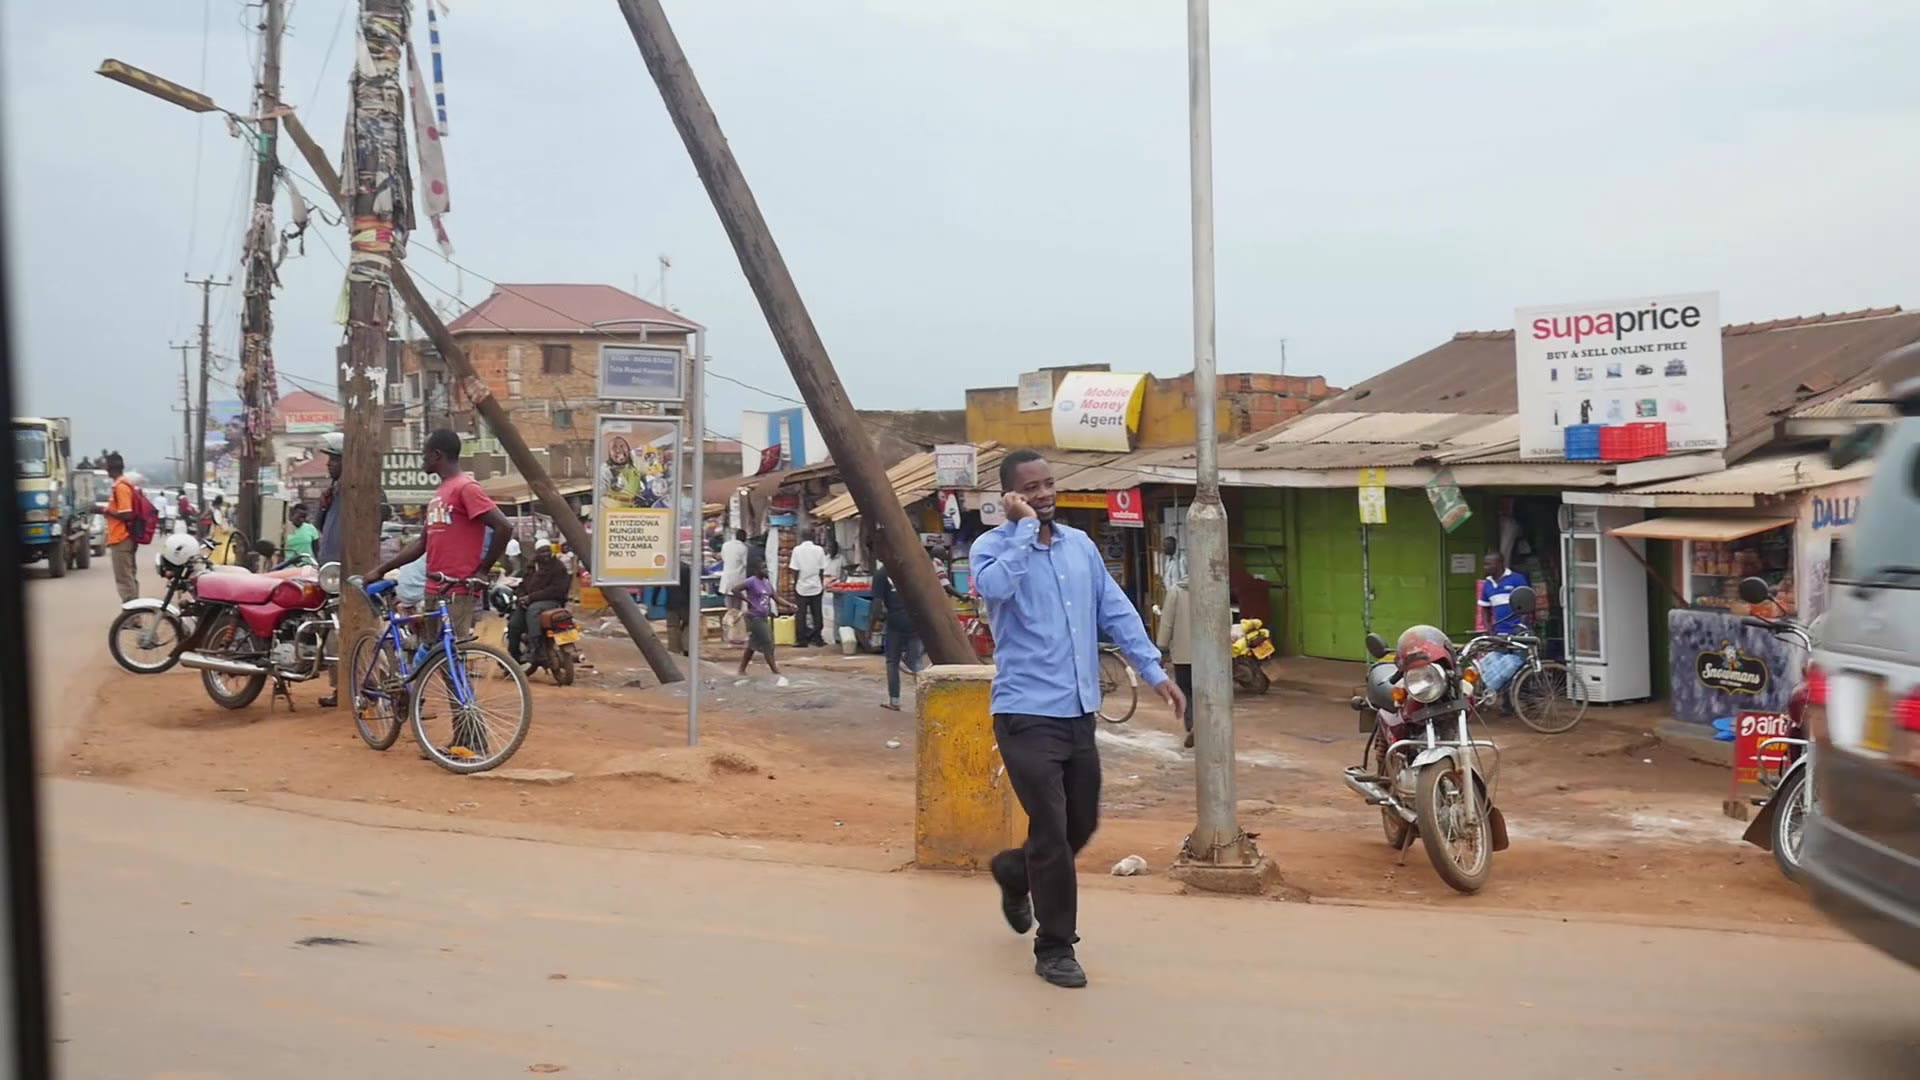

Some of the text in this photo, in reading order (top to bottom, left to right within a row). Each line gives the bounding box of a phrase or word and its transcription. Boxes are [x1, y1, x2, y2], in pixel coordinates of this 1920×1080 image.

[1532, 303, 1701, 344] supaprice
[1546, 341, 1688, 360] BUY & SELL ONLINE FREE
[1085, 387, 1130, 398] Mobile
[1081, 400, 1125, 412] Money
[1080, 413, 1123, 428] Agent
[389, 471, 442, 486] SCHOO
[1702, 663, 1760, 684] Snowmans
